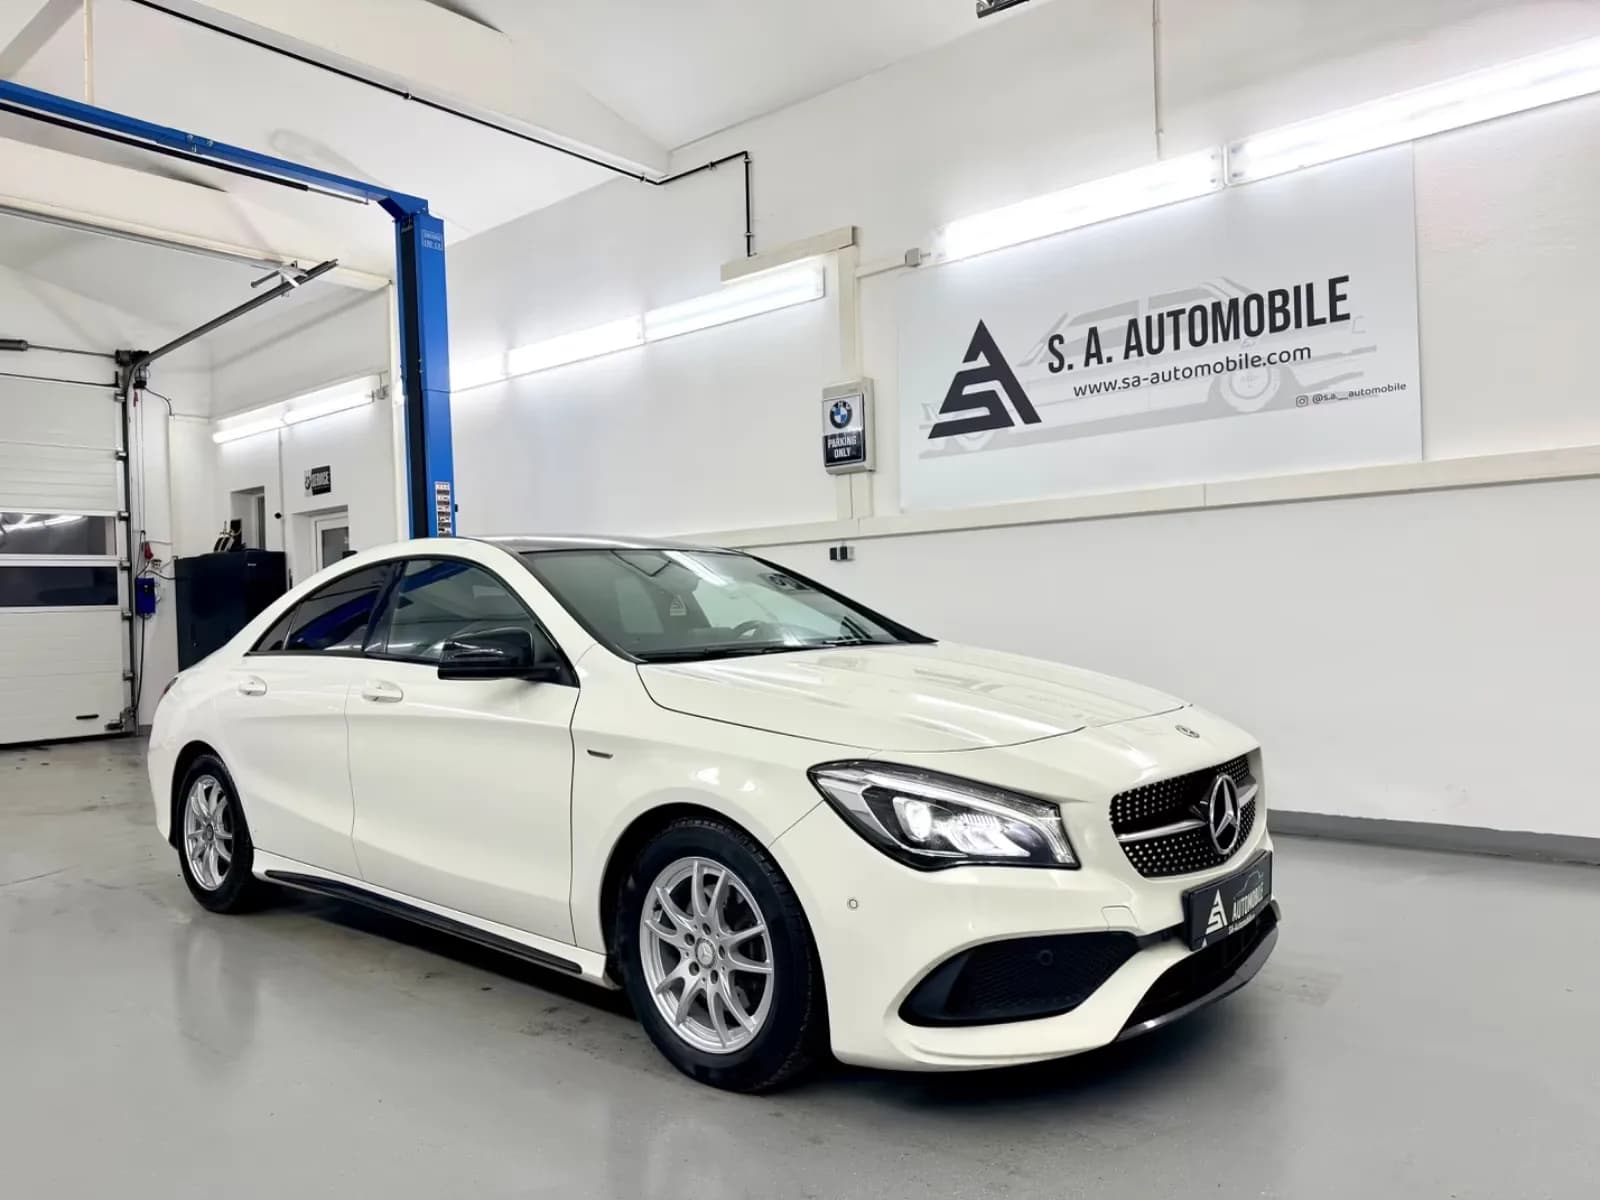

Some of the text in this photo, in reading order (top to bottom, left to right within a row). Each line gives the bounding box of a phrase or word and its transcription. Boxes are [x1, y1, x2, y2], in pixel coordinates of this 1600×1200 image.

[1048, 275, 1351, 374] S. A. AUTOMOBILE
[1073, 346, 1312, 397] www.sa-automobile.com
[827, 436, 856, 448] PARKING
[834, 447, 851, 458] ONLY
